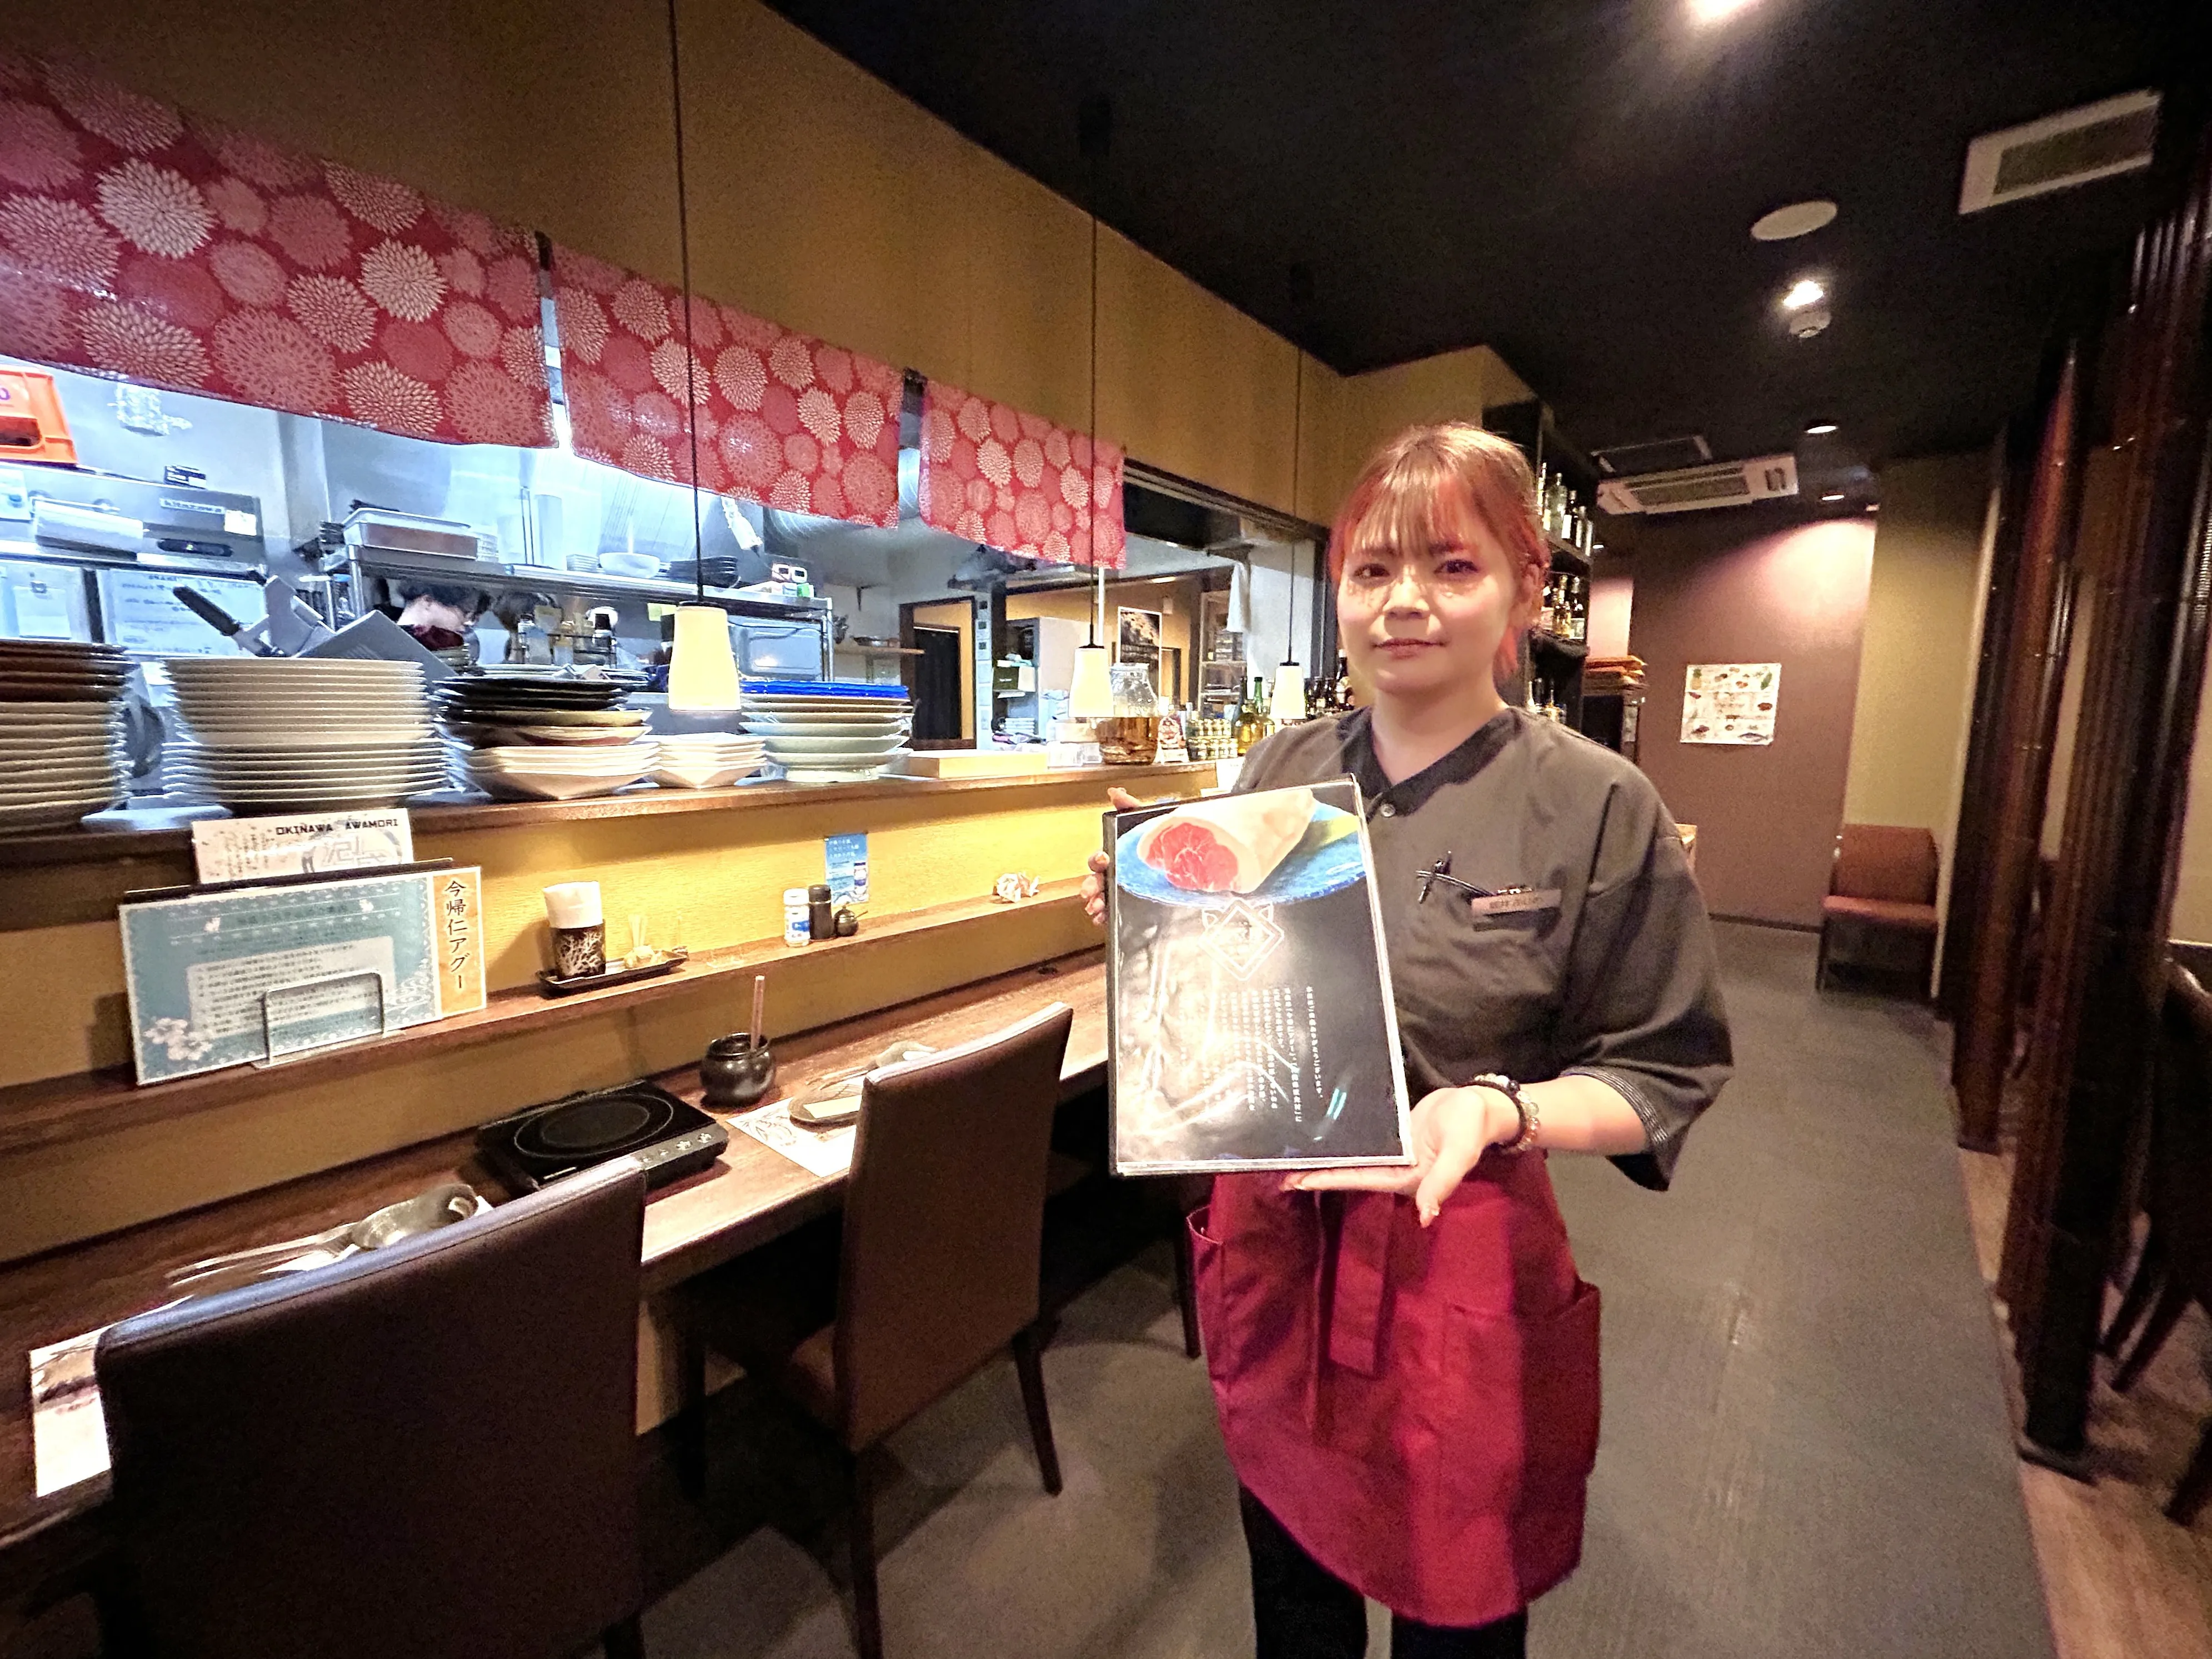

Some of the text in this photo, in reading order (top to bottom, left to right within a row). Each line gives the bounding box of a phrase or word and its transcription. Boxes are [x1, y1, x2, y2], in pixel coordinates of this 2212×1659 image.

[275, 819, 398, 835] OKINAWA AWAMORI
[445, 880, 471, 988] 今帰仁アグー
